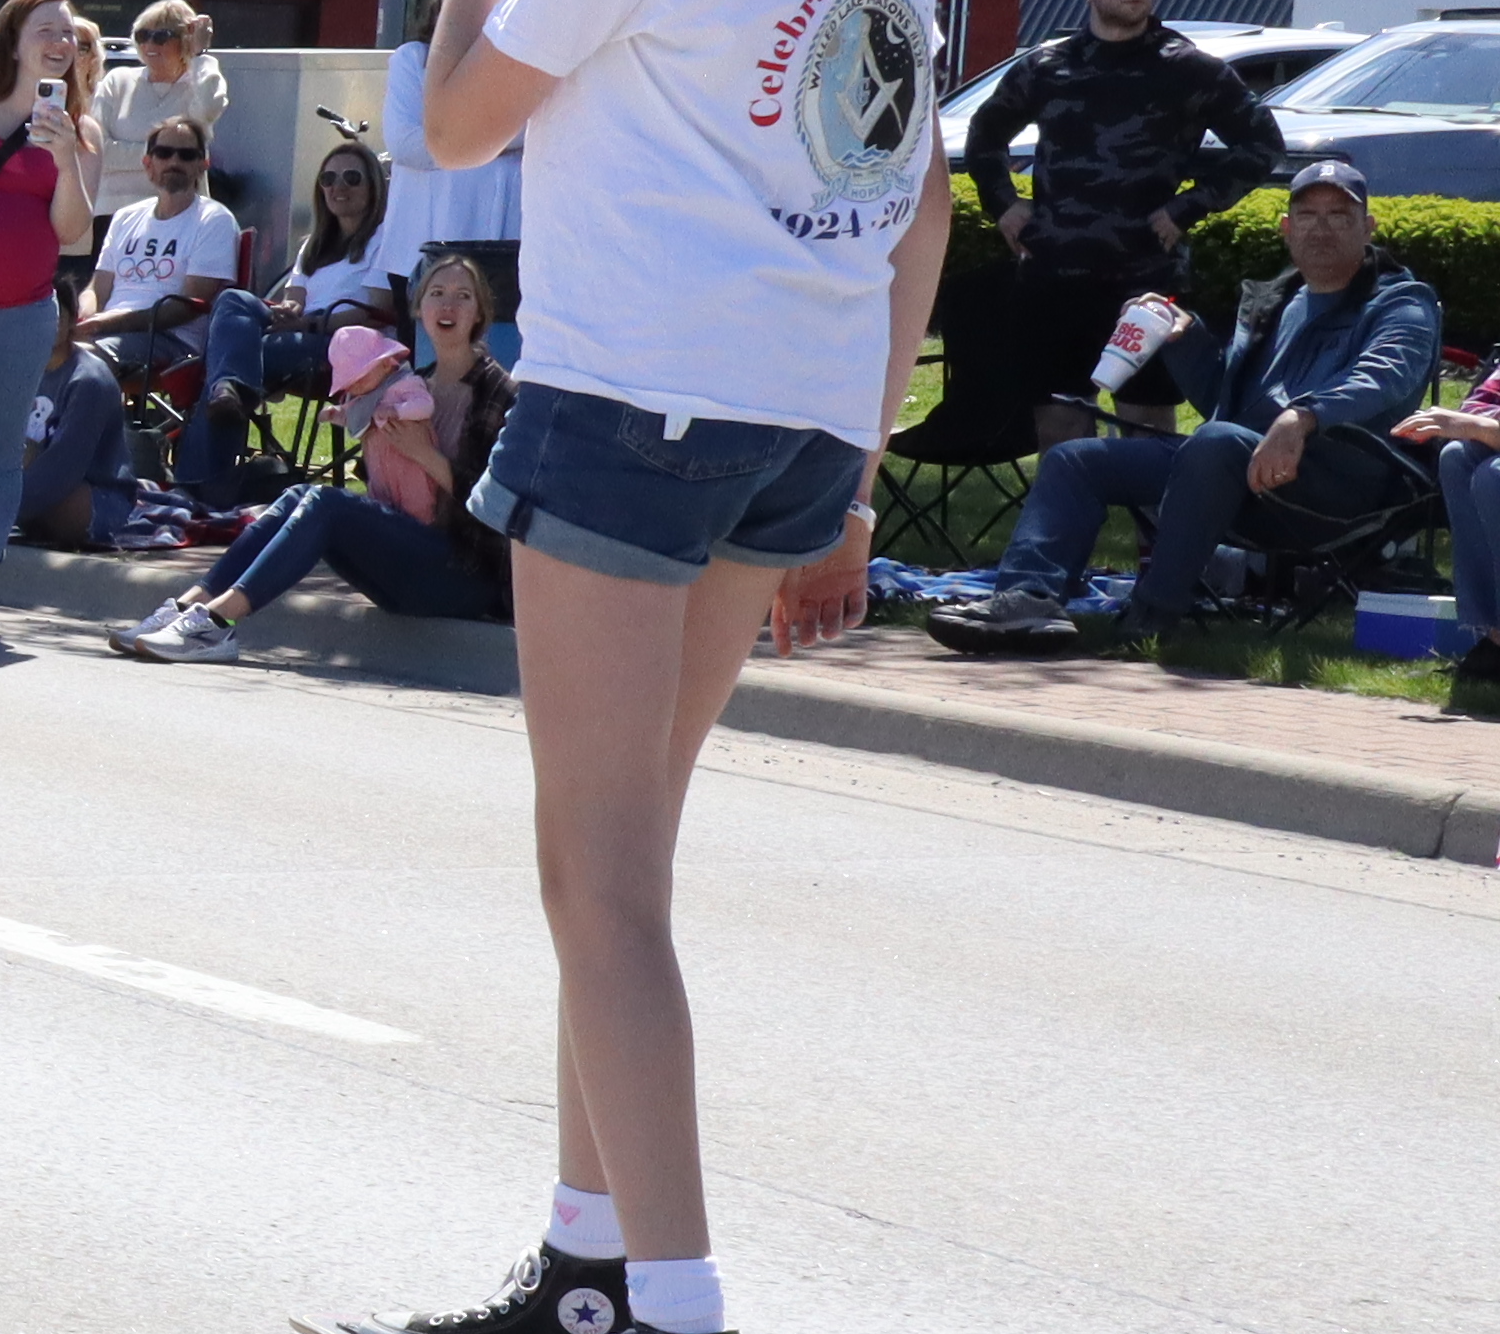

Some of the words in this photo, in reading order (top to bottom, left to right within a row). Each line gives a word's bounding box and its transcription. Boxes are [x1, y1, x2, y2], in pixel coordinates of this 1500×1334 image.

[808, 19, 838, 91] WALLED
[850, 186, 882, 200] HOPE
[124, 238, 178, 257] USA
[1117, 322, 1146, 342] BIG
[1108, 332, 1143, 354] GULP
